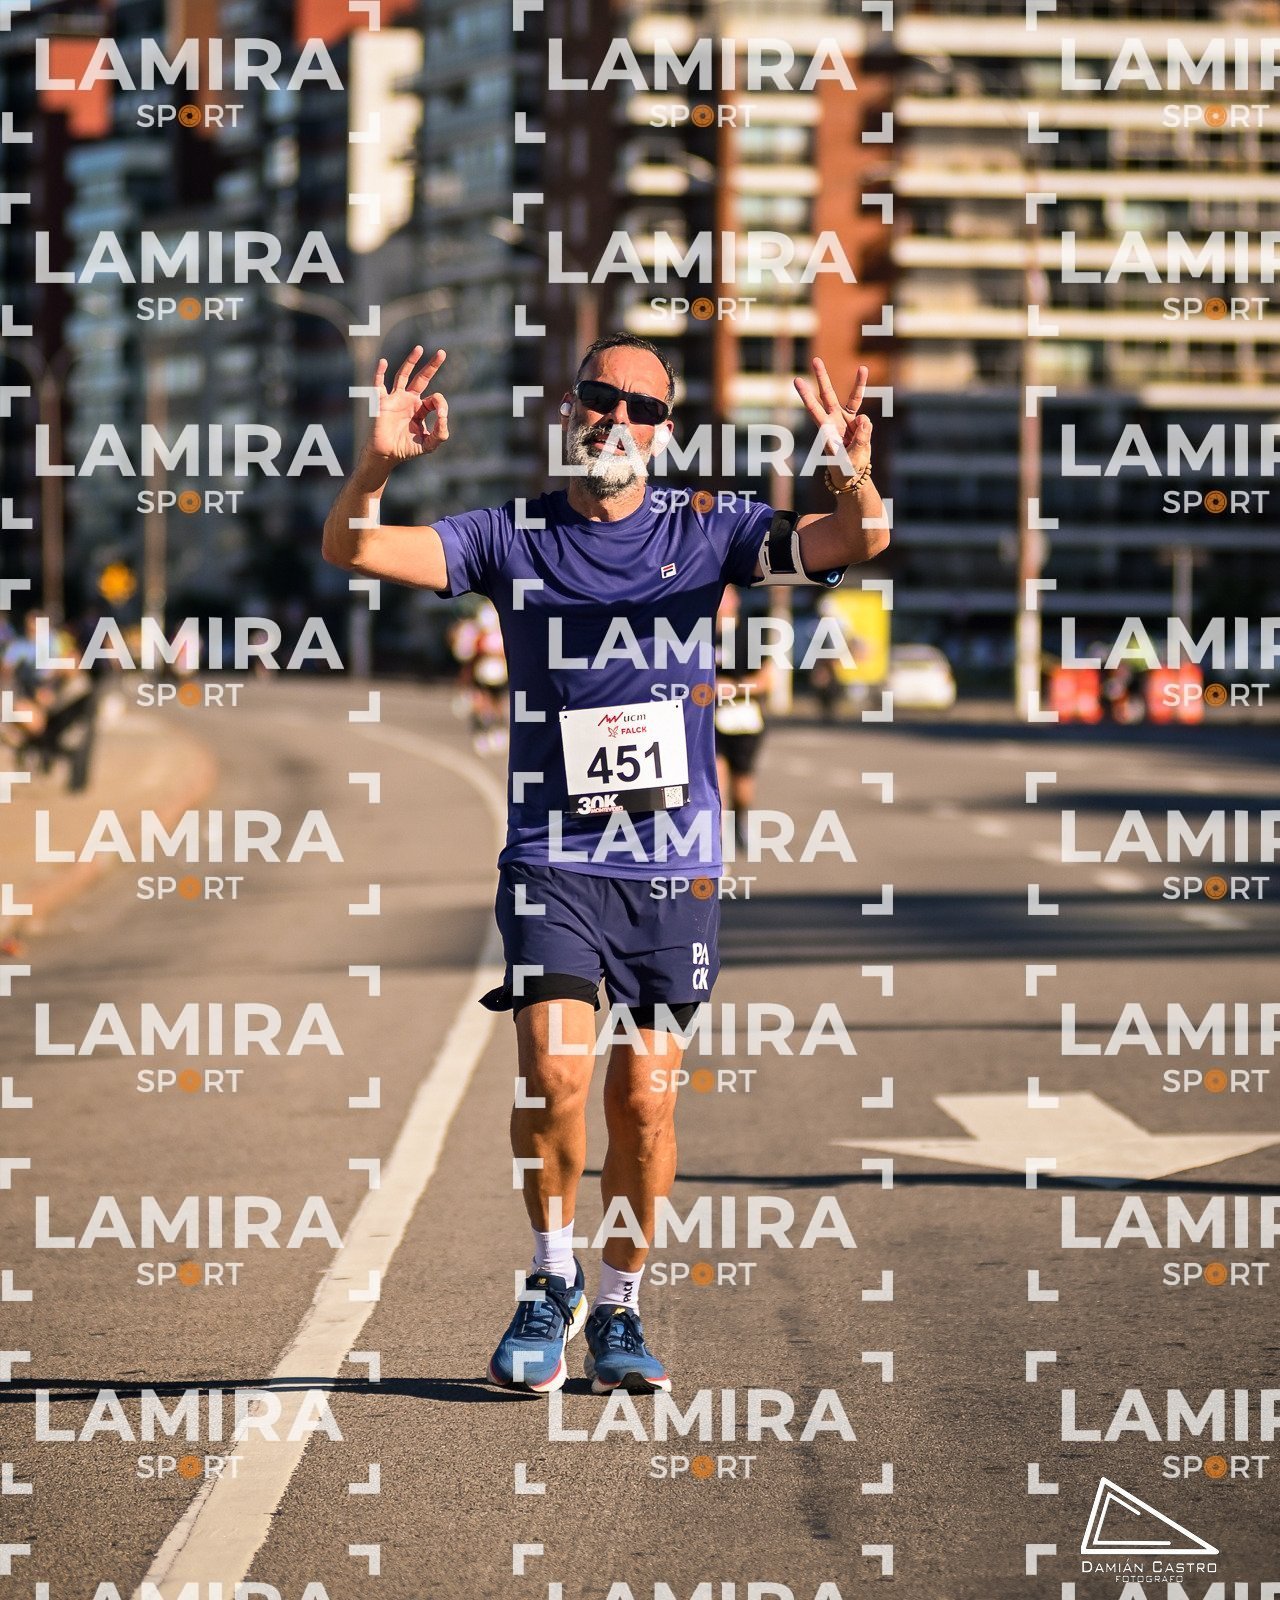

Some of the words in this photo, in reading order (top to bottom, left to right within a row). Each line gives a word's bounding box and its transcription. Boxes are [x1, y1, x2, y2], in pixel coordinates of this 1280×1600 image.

[621, 726, 647, 735] FALCK
[587, 741, 663, 784] 451
[577, 794, 619, 815] 30K
[692, 942, 710, 966] PA
[692, 967, 709, 991] CK
[623, 1280, 634, 1303] PACK
